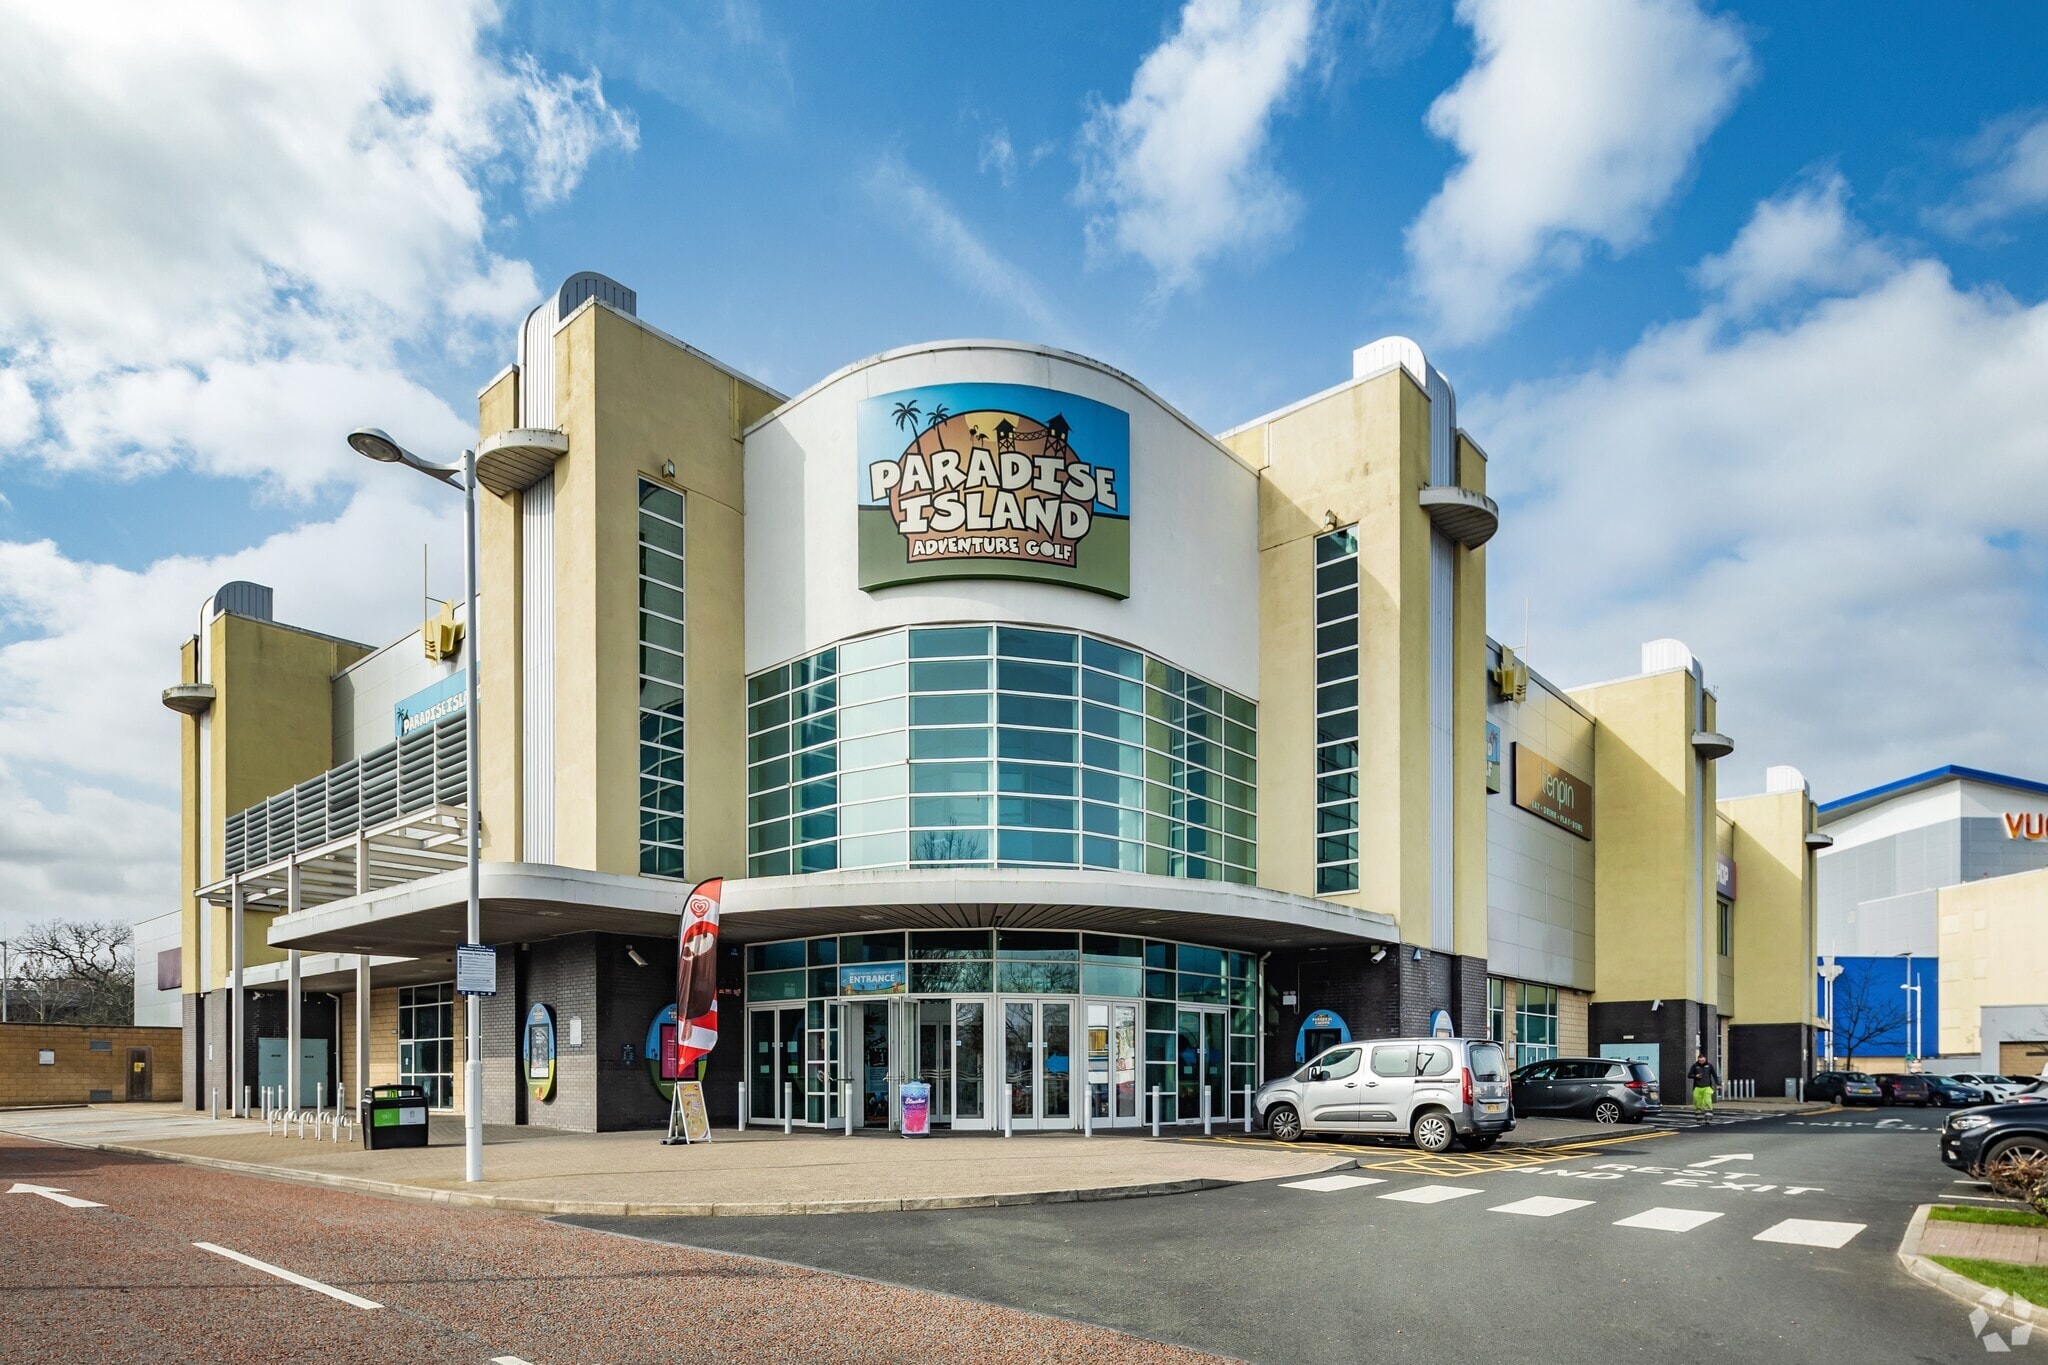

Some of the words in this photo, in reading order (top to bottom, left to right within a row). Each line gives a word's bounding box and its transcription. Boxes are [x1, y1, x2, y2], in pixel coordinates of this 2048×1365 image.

[869, 447, 1118, 511] PARADISE
[898, 488, 1091, 541] ISLAND
[912, 536, 1020, 557] ADVENTURE
[1026, 540, 1073, 562] GOLF
[403, 702, 447, 734] PARADISE
[1541, 760, 1575, 811] tenpin
[1531, 800, 1540, 811] EAT
[2003, 812, 2048, 840] VU
[849, 973, 895, 984] ENTRANCE
[1502, 1167, 1625, 1180] AND
[1660, 1178, 1825, 1195] EXIT
[1592, 1163, 1760, 1180] REST
